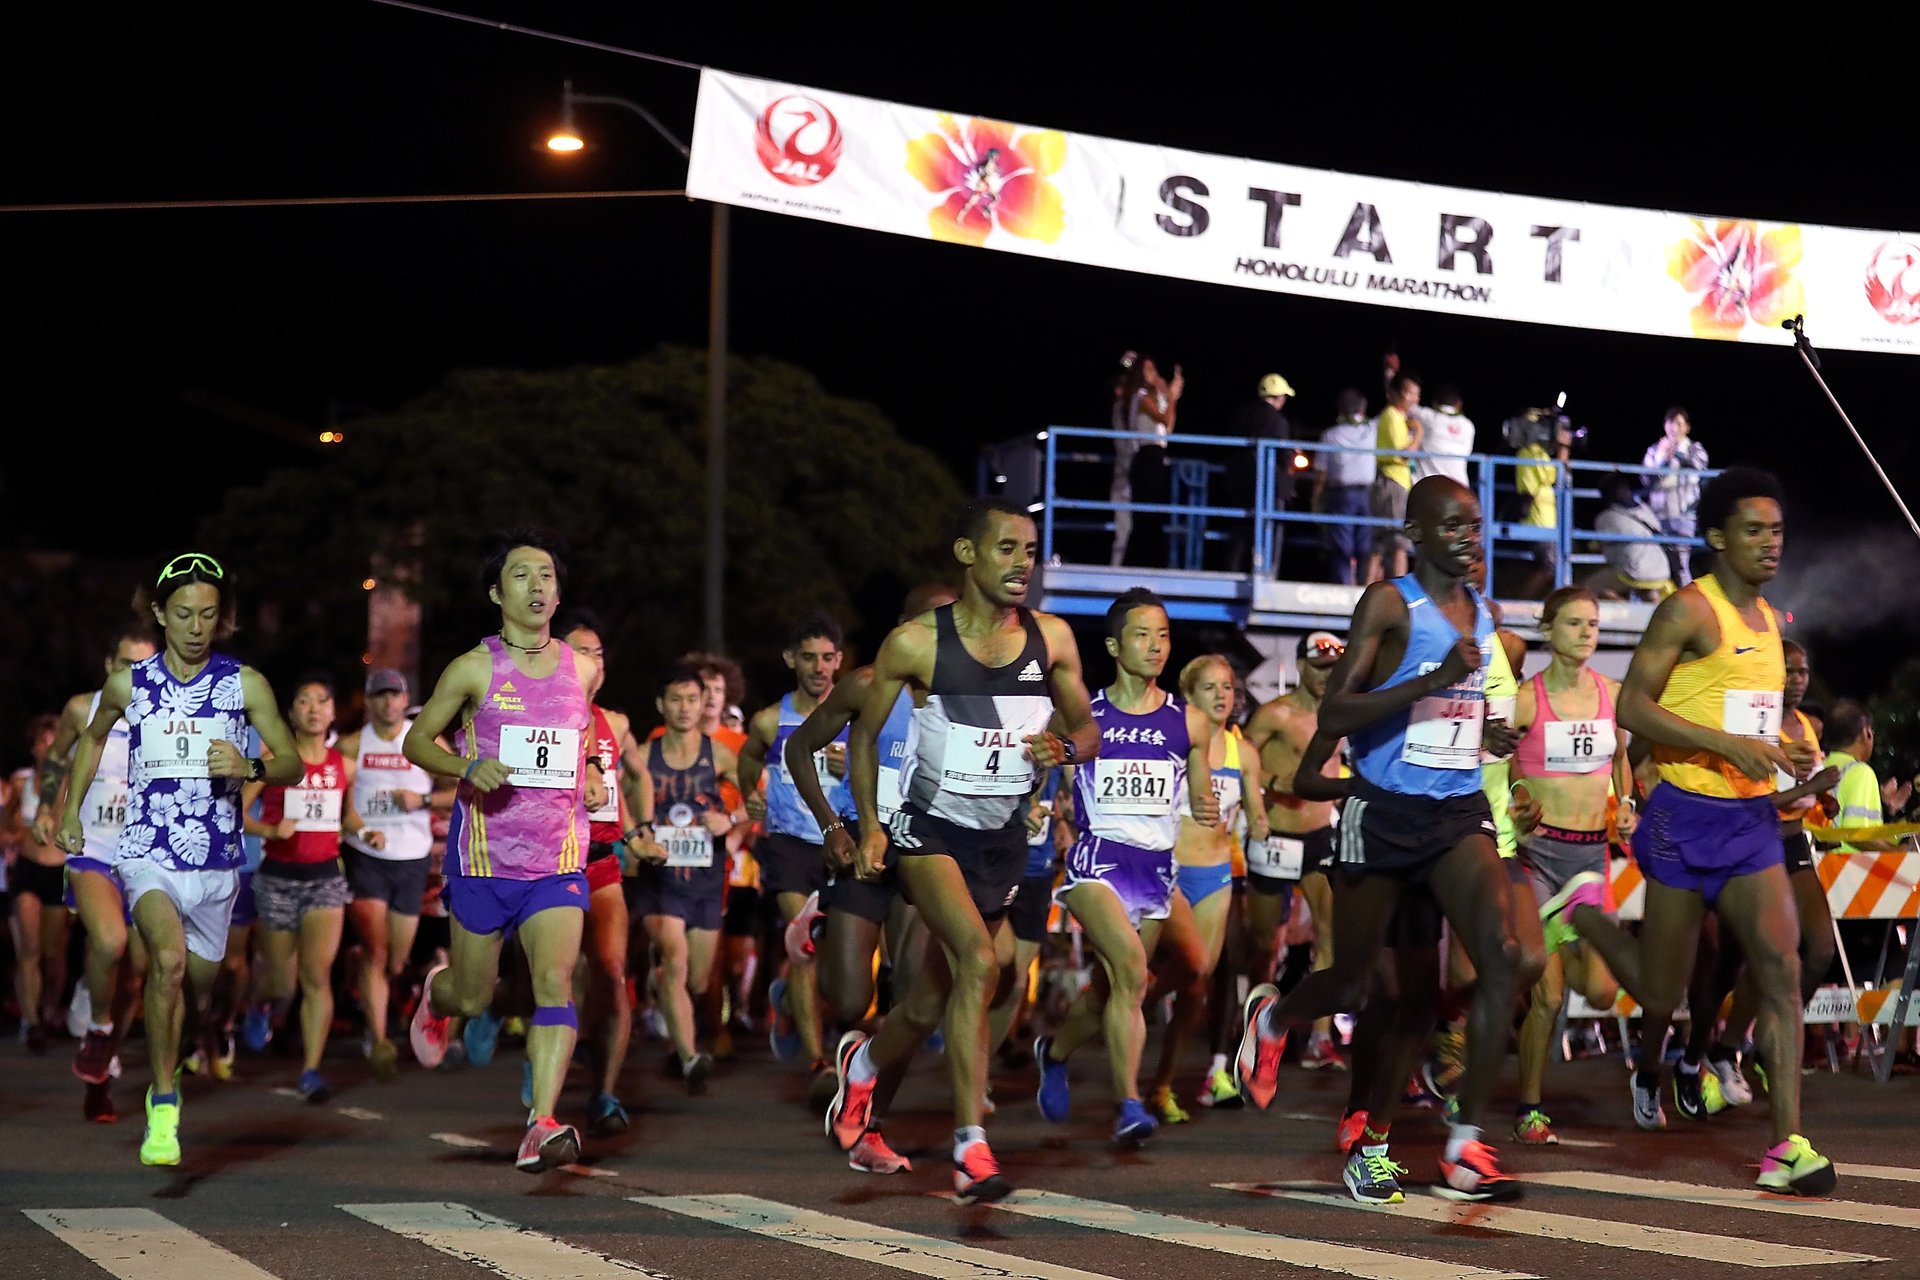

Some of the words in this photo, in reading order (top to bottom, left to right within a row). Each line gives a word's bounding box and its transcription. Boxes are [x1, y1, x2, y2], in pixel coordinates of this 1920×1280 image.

[772, 158, 825, 182] JAL
[1154, 175, 1581, 284] START
[1233, 256, 1359, 288] HONOLULU
[1366, 274, 1491, 304] MARATHON
[1440, 701, 1475, 719] JAL
[1748, 693, 1776, 708] JAL
[163, 720, 202, 735] JAL
[1567, 723, 1598, 736] JAL
[1756, 710, 1769, 735] 2
[525, 729, 562, 745] JAL
[974, 731, 1017, 748] JAL
[1450, 721, 1462, 747] 7
[175, 736, 190, 759] 9
[535, 745, 550, 769] 8
[1573, 736, 1594, 757] F6
[985, 750, 1001, 775] 4
[1117, 762, 1153, 776] JAL
[1102, 776, 1166, 798] 23847
[305, 803, 323, 819] 26
[1266, 850, 1280, 864] 14
